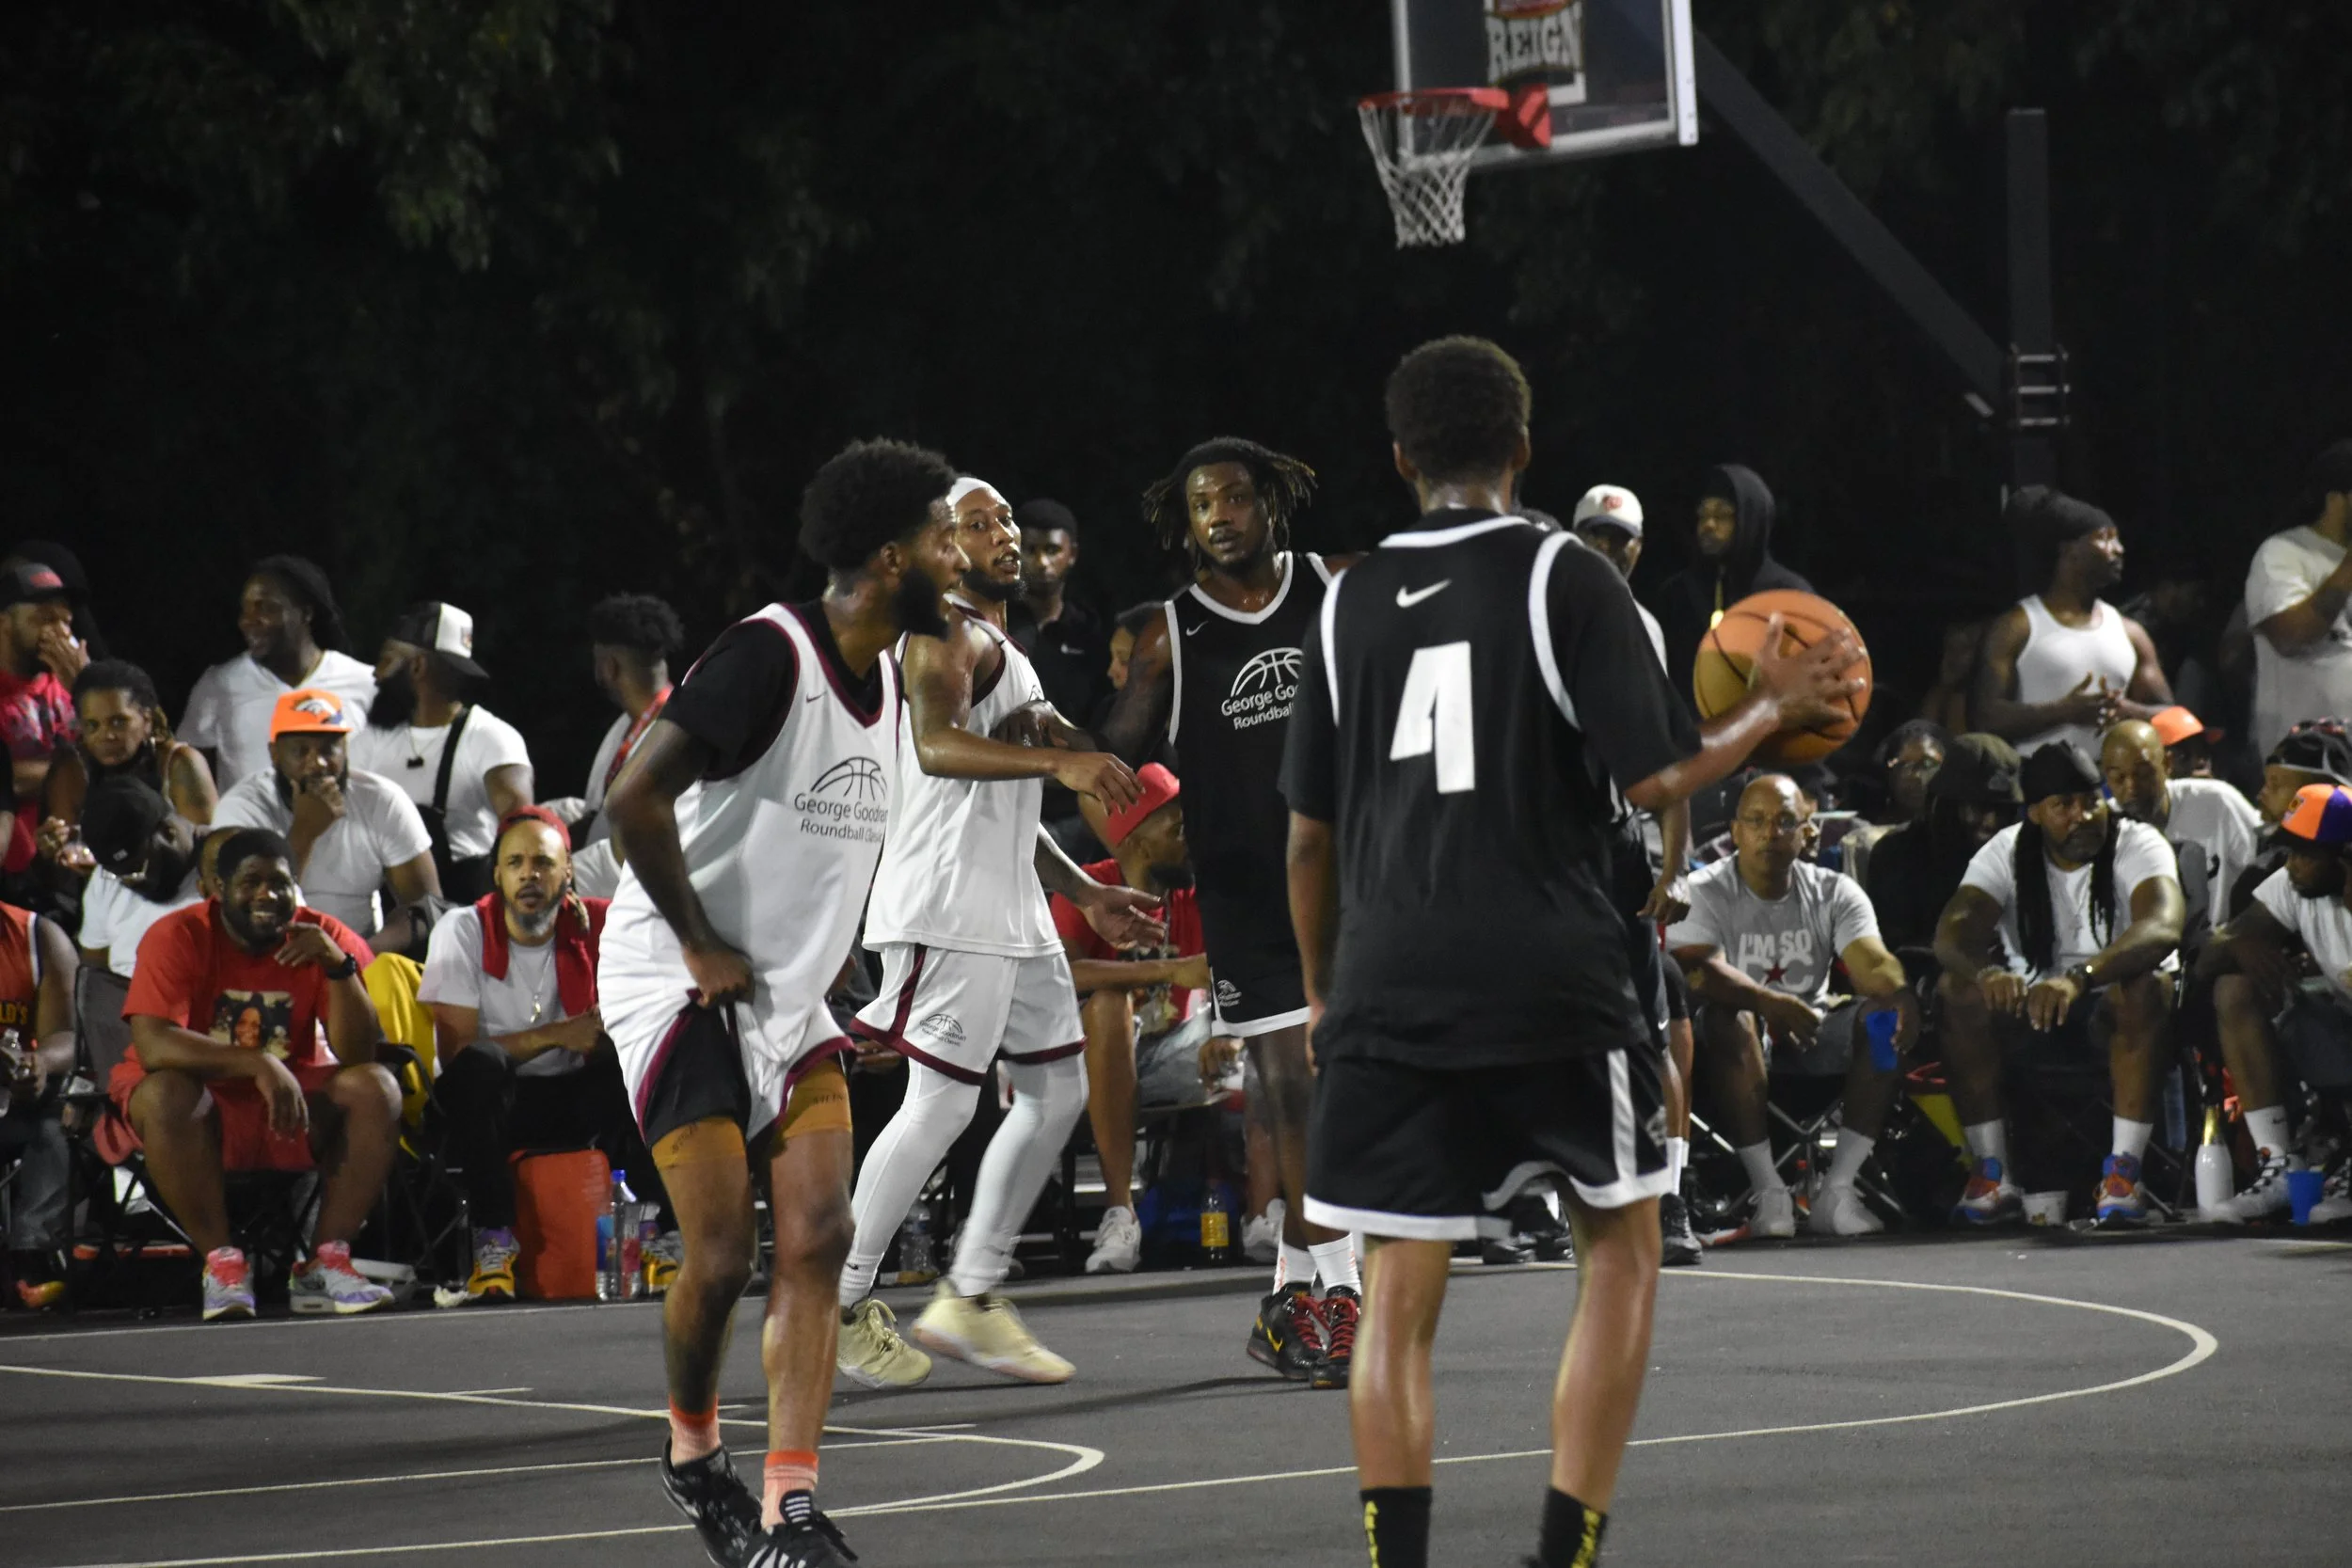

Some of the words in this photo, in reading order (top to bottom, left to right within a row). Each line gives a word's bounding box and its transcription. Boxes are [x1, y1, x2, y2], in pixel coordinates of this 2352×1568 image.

[1486, 3, 1581, 84] REIGN
[1221, 689, 1273, 716] George
[1390, 641, 1475, 794] 4
[794, 793, 851, 821] George
[800, 818, 865, 840] Roundball
